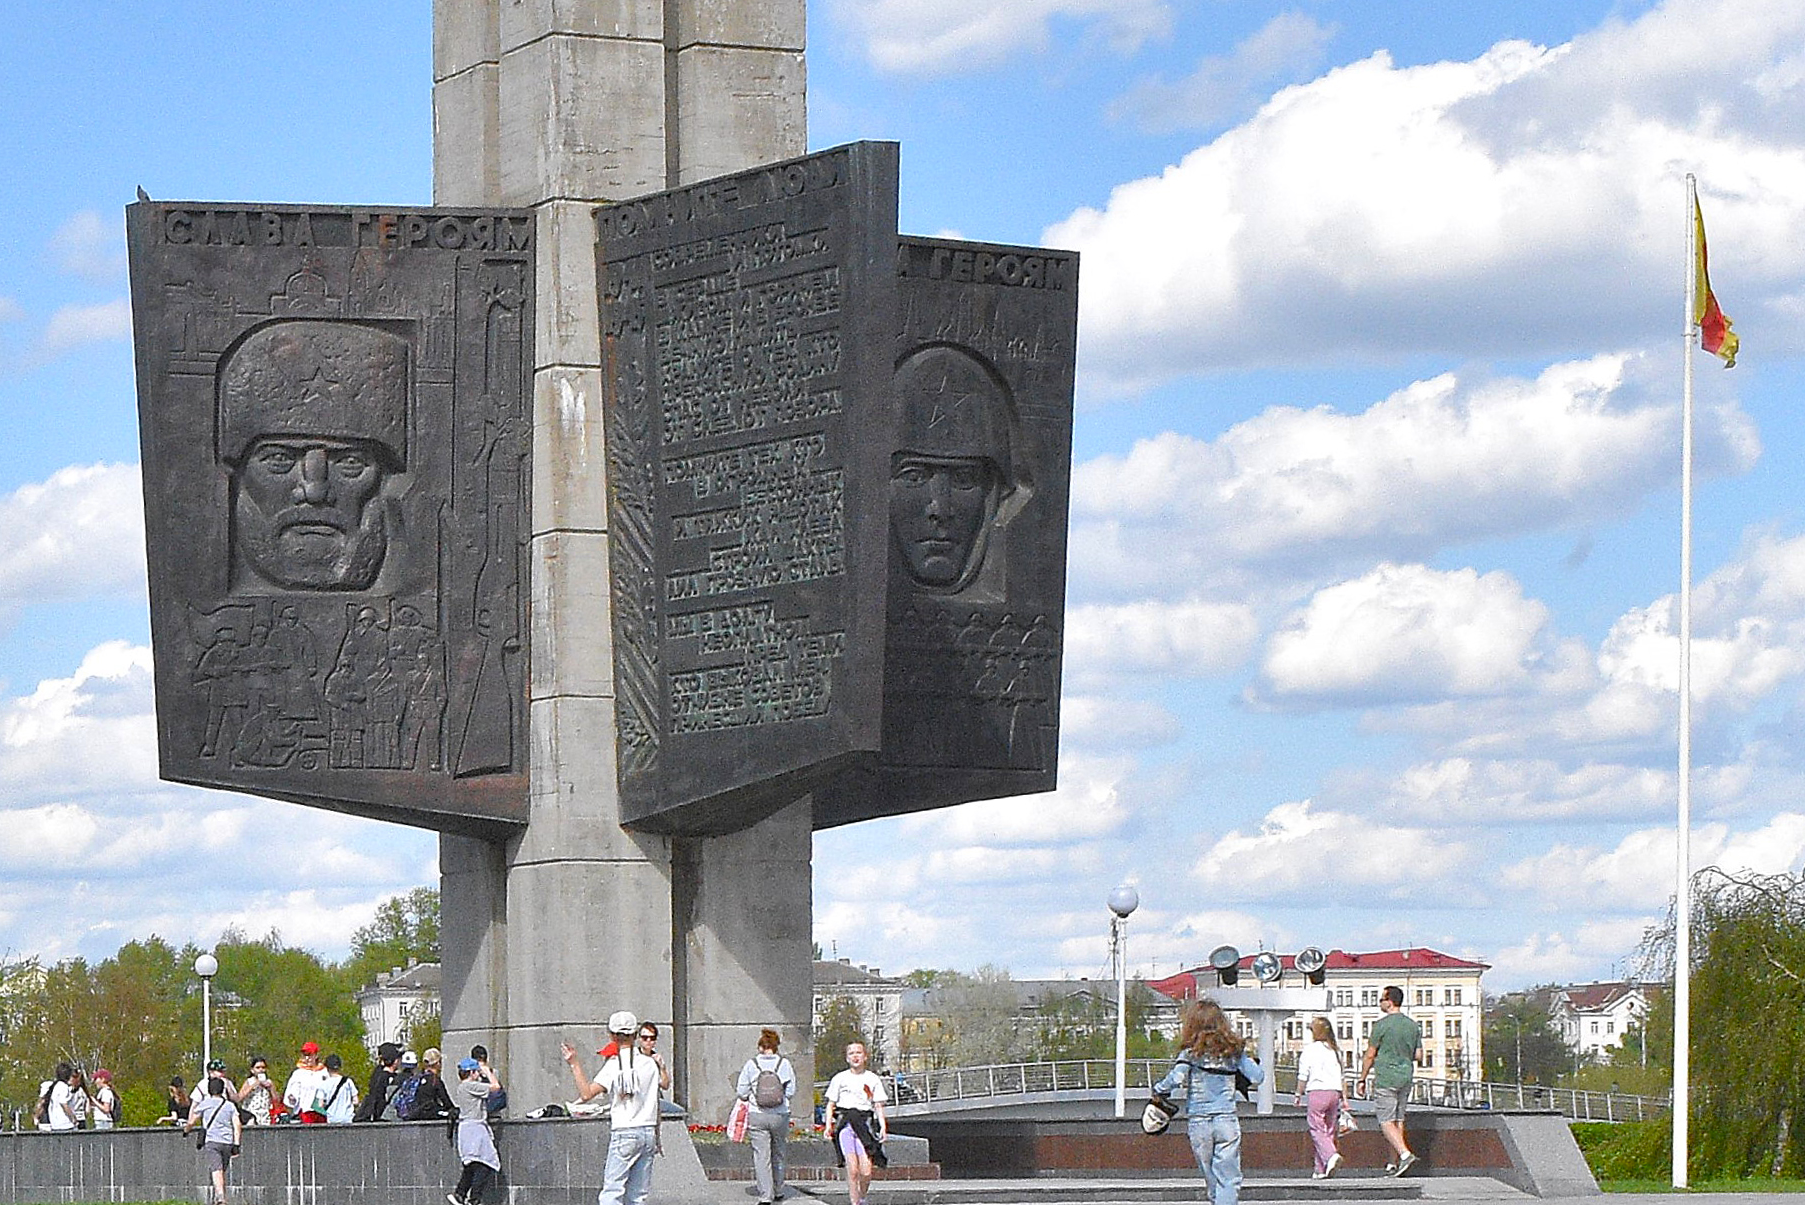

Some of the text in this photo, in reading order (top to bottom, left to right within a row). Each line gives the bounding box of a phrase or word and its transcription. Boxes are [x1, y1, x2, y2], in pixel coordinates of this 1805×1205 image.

[166, 211, 532, 251] СЛАВА ГЕРОЯМ
[930, 247, 1067, 290] ГЕРОЯМ
